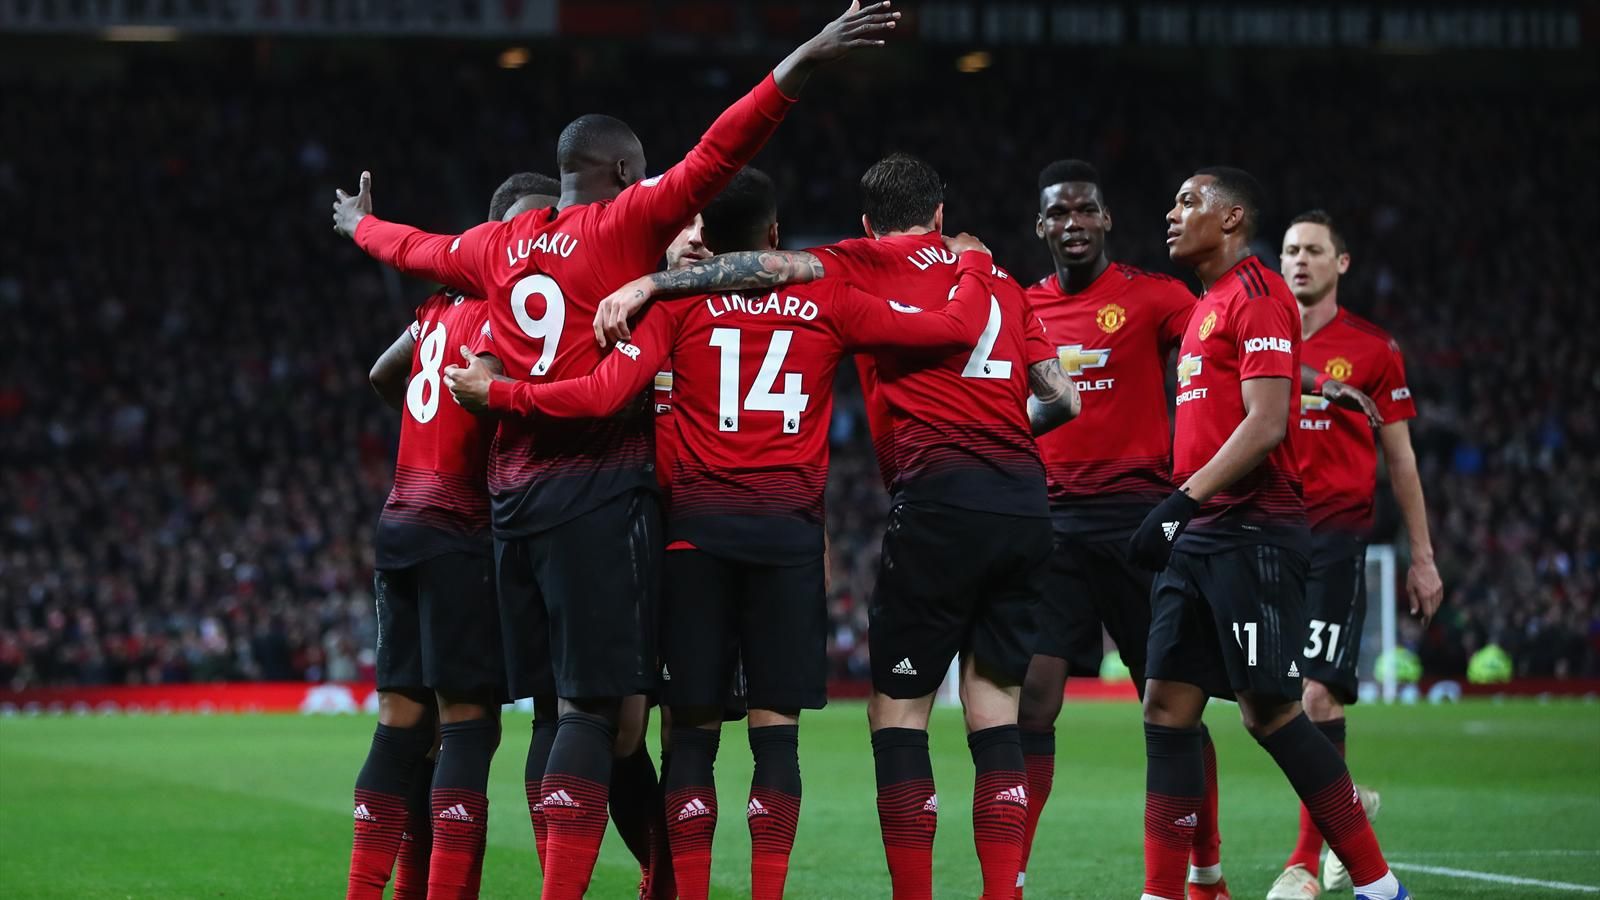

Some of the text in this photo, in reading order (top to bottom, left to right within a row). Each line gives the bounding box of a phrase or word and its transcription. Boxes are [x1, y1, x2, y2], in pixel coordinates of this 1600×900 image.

[705, 291, 819, 321] LINGARD
[511, 273, 566, 377] 9
[1243, 336, 1292, 354] KOHLER
[708, 327, 810, 434] 14
[1303, 619, 1341, 663] 31
[892, 667, 917, 676] adidas
[543, 799, 580, 808] adidas
[995, 793, 1028, 808] adidas
[439, 812, 473, 822] adidas
[678, 807, 710, 821] adidas
